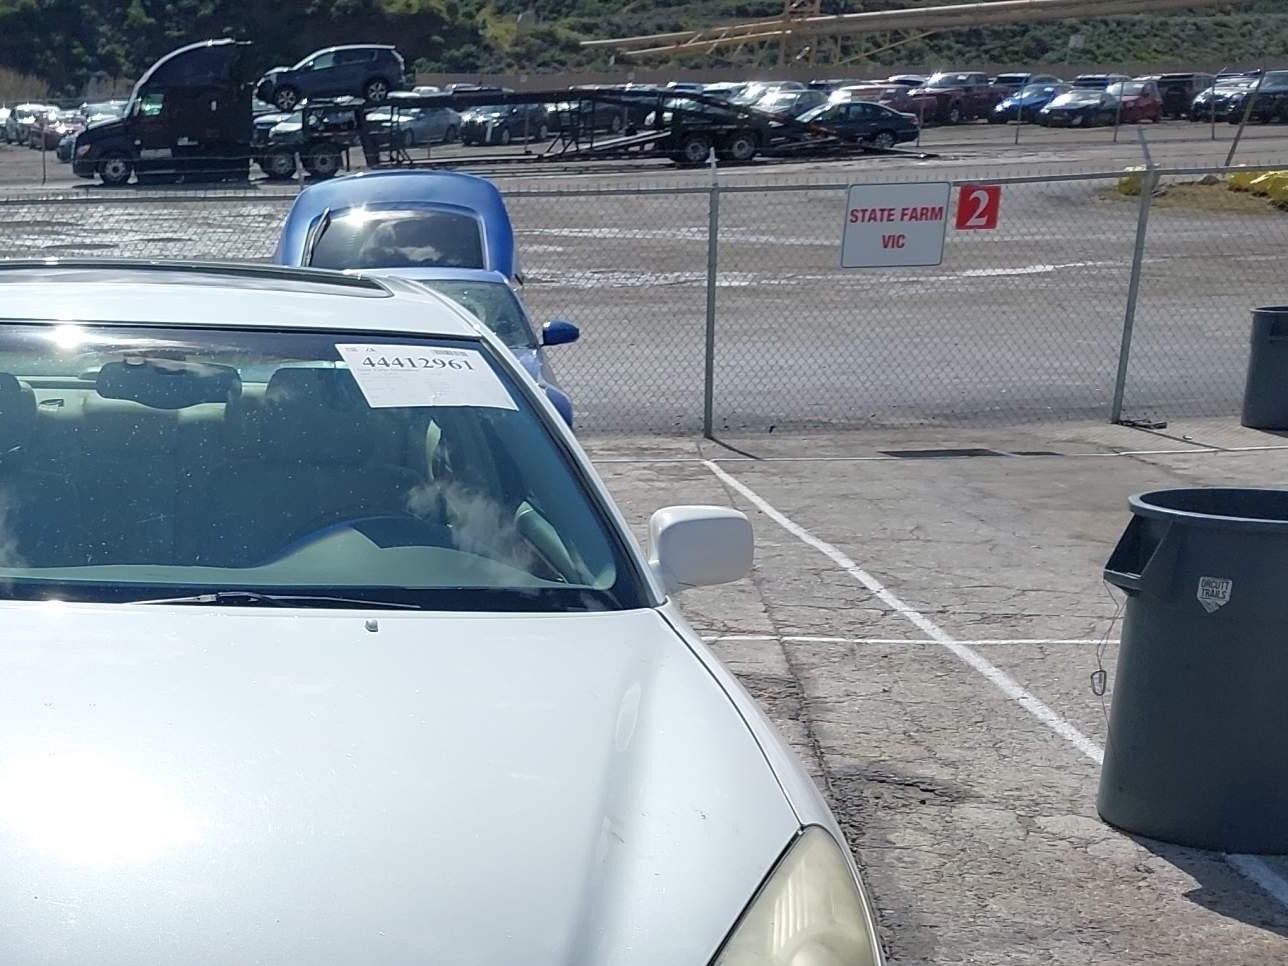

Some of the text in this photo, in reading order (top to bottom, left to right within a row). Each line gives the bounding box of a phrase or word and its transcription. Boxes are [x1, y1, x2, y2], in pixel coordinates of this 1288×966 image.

[849, 206, 944, 223] STATE FARM
[965, 190, 990, 226] 2
[882, 234, 906, 249] VIC
[362, 356, 475, 372] 44412961
